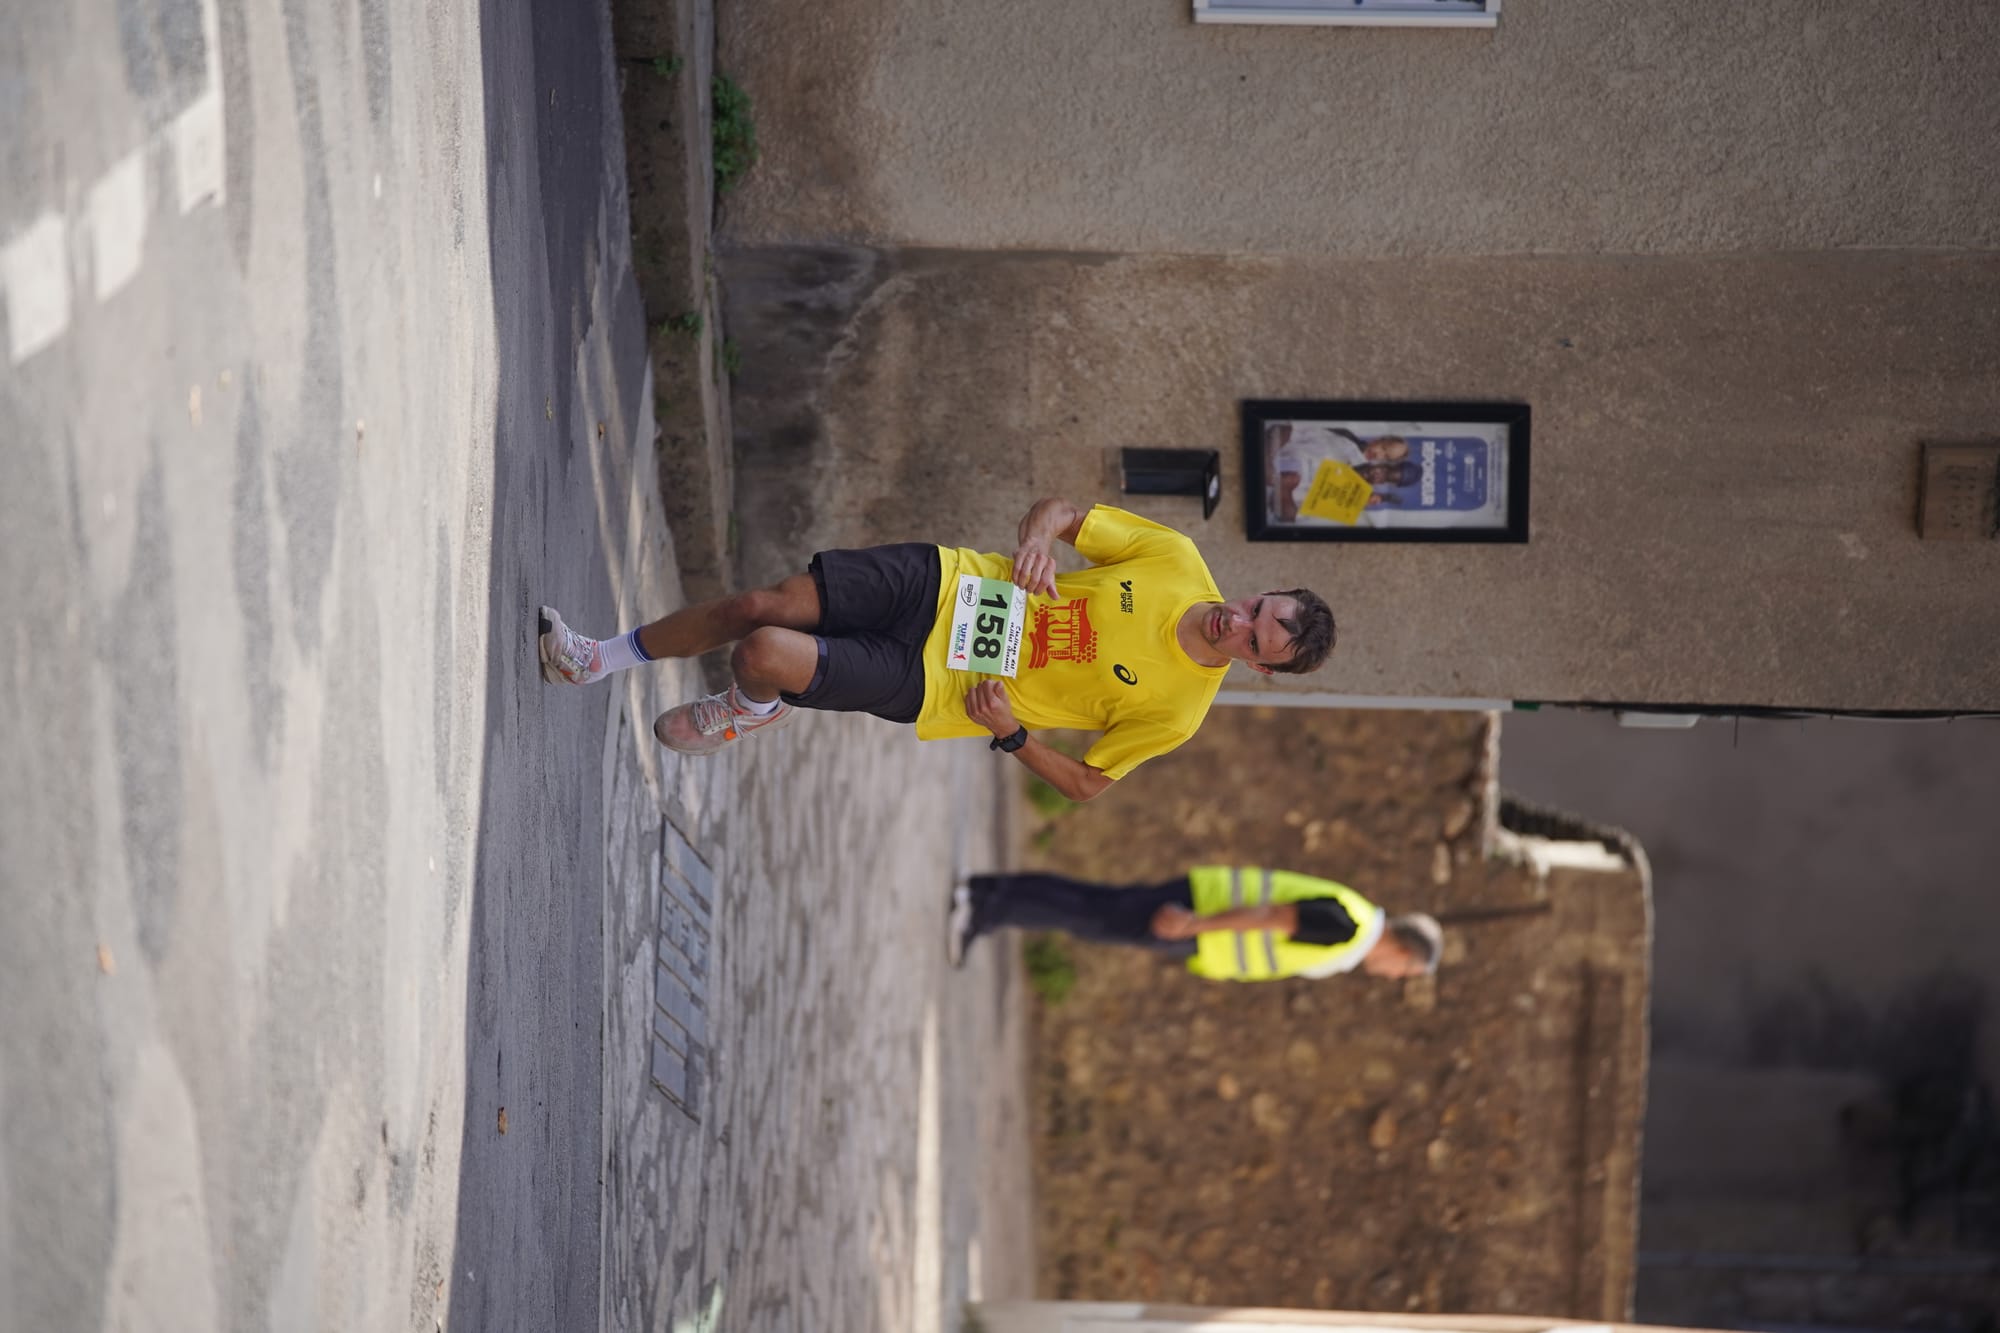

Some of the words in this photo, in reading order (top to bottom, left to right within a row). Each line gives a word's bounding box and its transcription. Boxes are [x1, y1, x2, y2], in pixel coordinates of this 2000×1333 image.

[1422, 442, 1441, 505] RÉPONDEUR
[959, 623, 968, 651] TUFF'S
[973, 593, 1008, 659] 158
[1010, 626, 1021, 656] Challenge
[1047, 609, 1071, 656] RUN
[1072, 608, 1080, 656] MONTPELLIER
